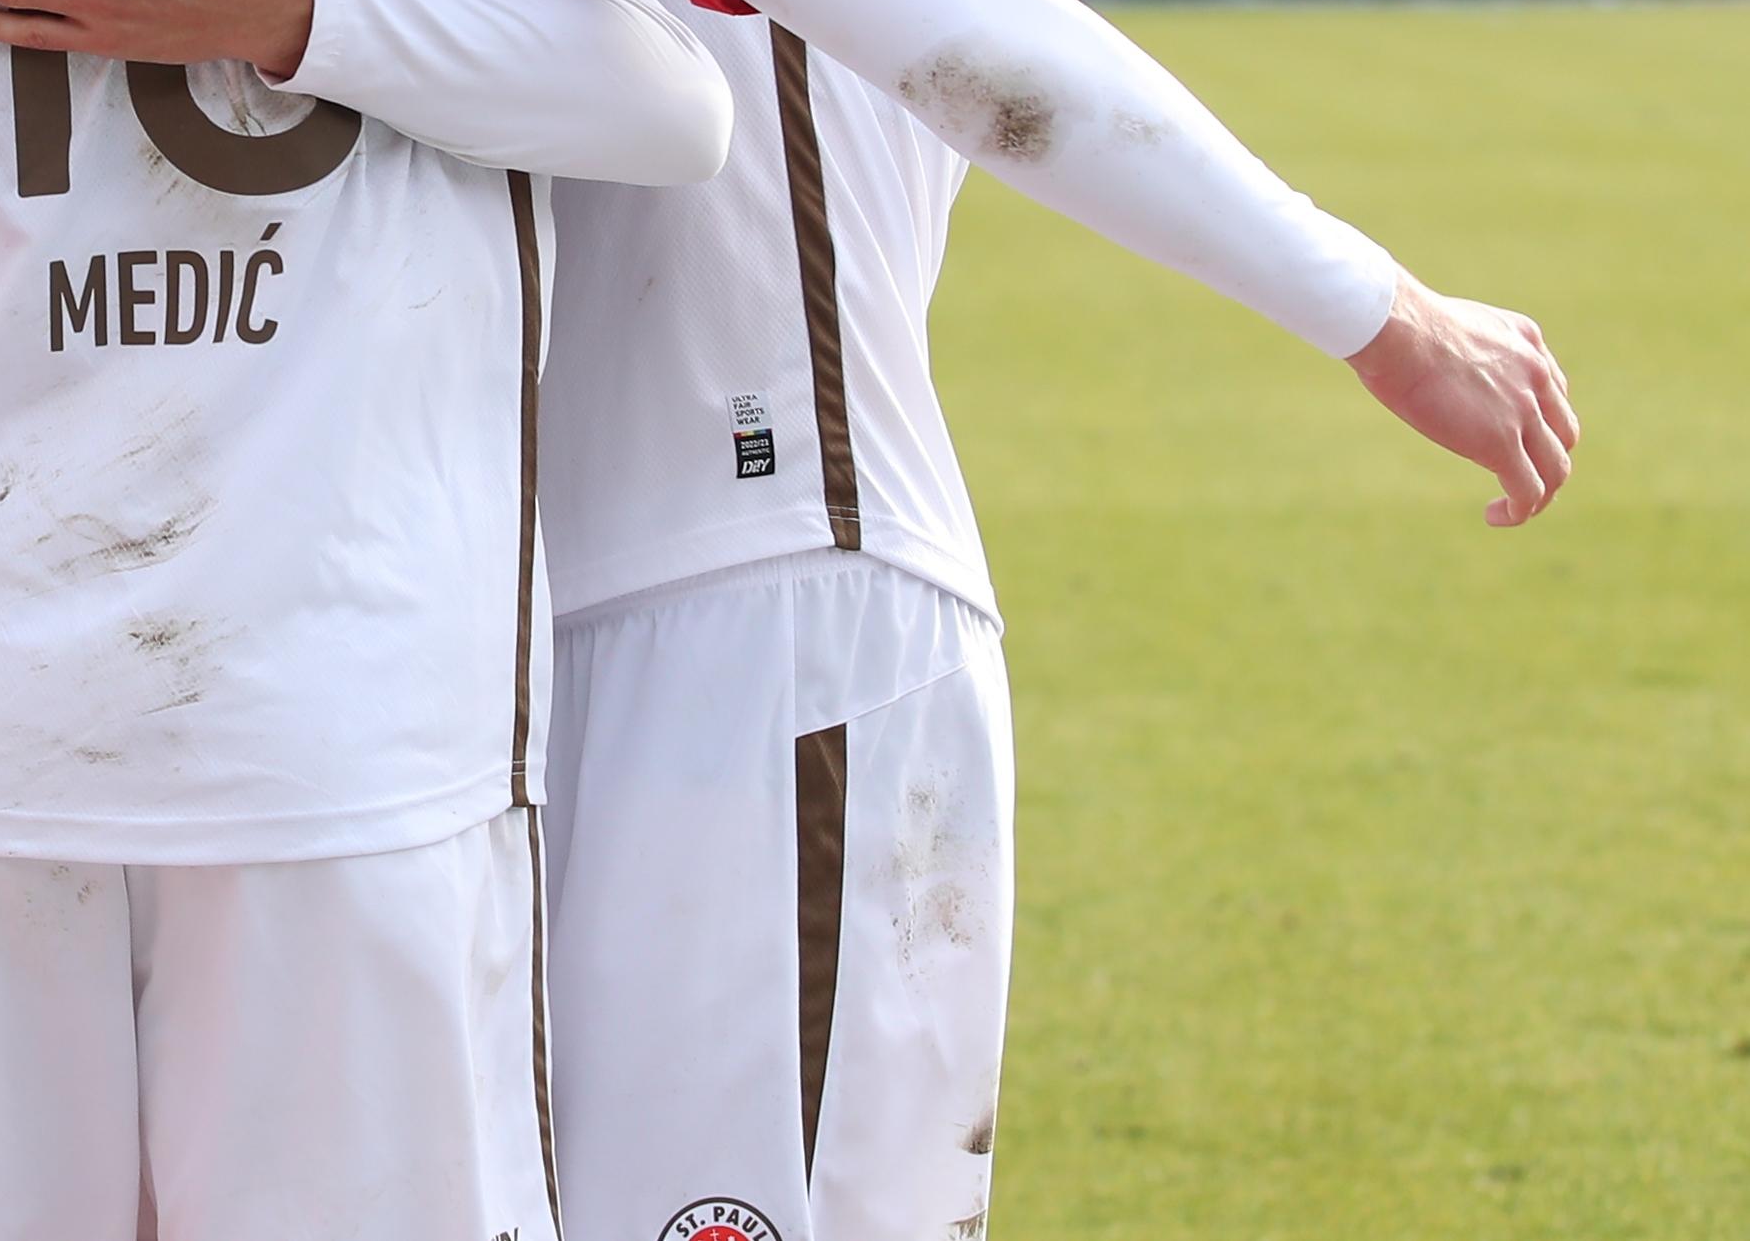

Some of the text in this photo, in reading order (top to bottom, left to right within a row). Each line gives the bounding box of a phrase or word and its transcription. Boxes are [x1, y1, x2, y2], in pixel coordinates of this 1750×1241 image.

[50, 222, 284, 352] MEDIĆ
[736, 416, 760, 424] WEAR
[676, 1213, 706, 1238] ST.
